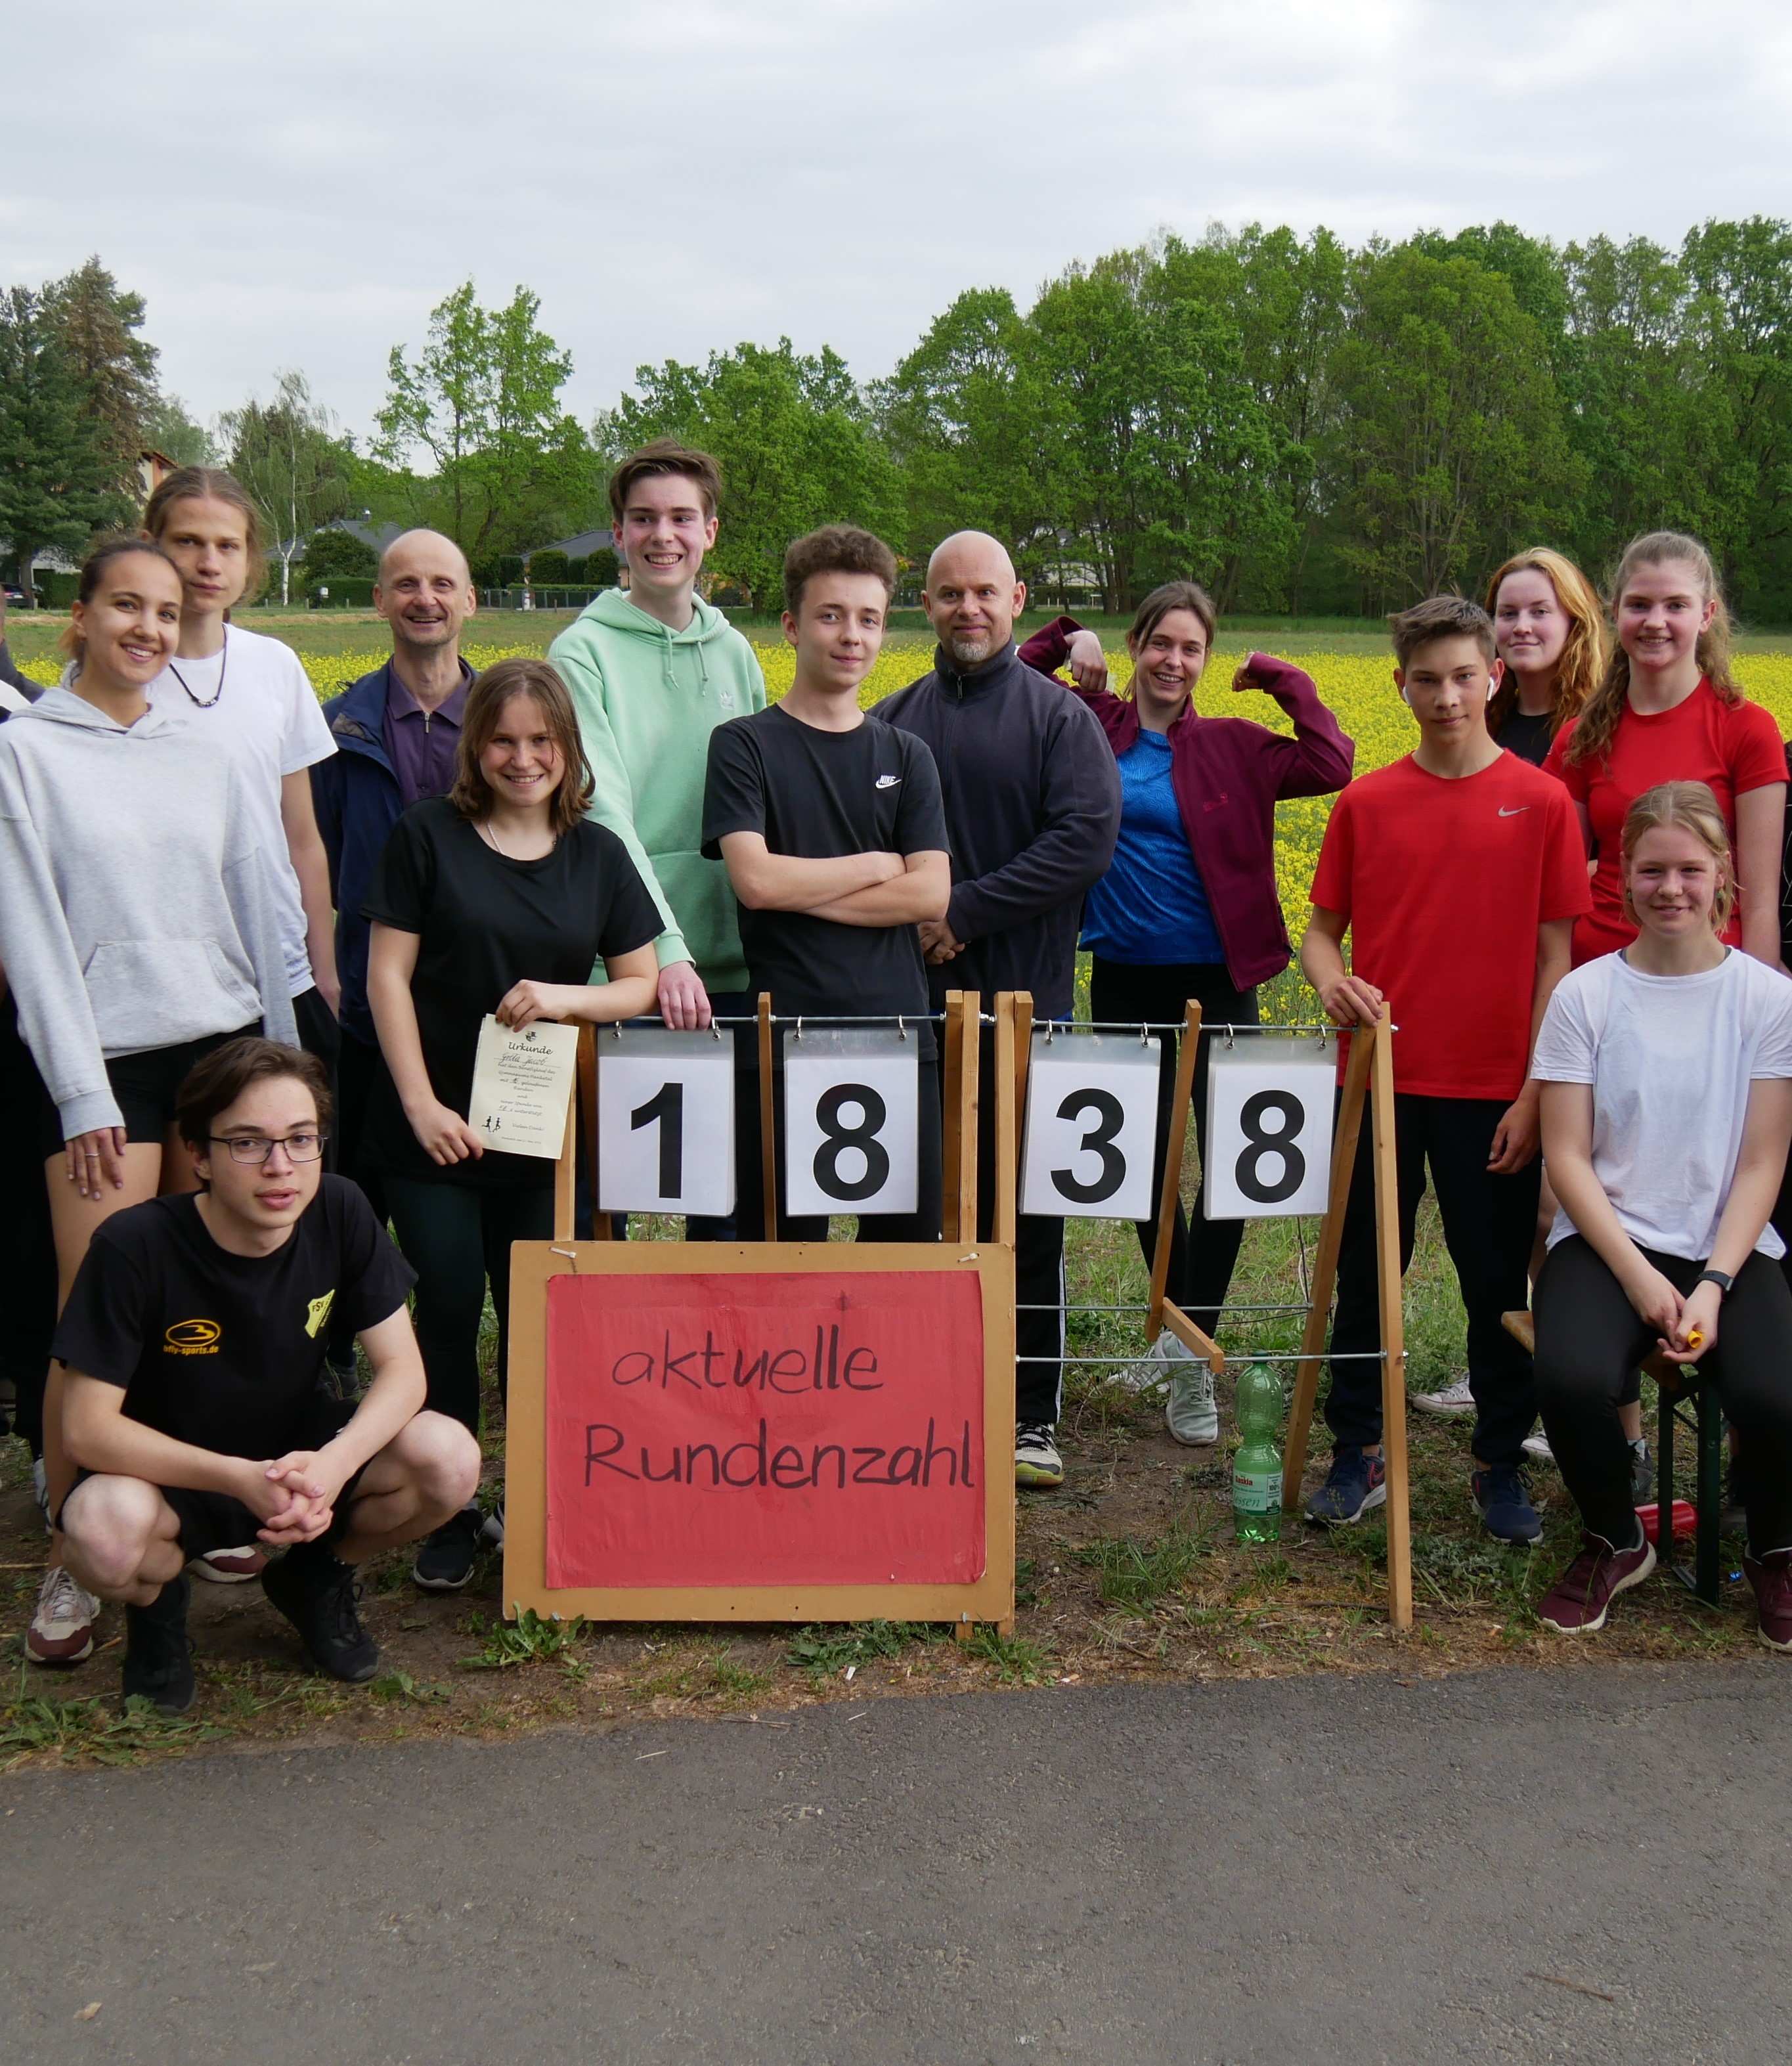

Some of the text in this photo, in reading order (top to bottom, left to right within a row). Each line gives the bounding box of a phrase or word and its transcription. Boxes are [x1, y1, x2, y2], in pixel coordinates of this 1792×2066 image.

[879, 775, 896, 785] NIKE
[508, 1042, 553, 1055] Urkunde
[631, 1083, 1305, 1203] 1 8 3 8
[612, 1325, 884, 1394] aktuelle
[584, 1417, 975, 1489] Rundenzahl
